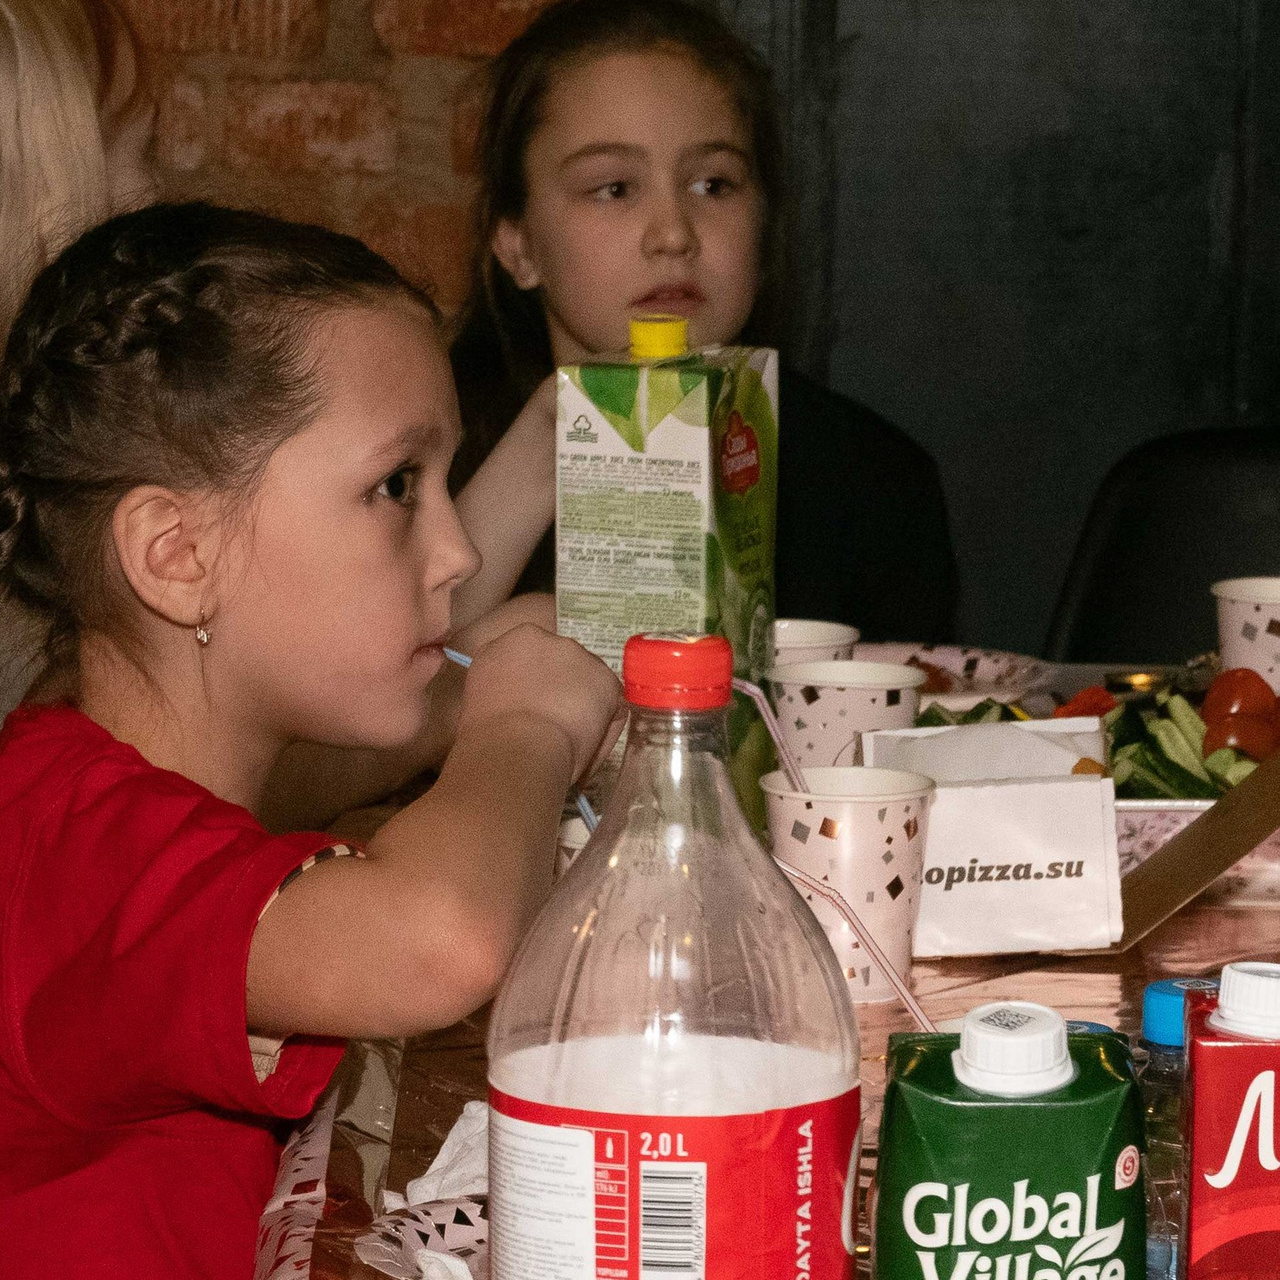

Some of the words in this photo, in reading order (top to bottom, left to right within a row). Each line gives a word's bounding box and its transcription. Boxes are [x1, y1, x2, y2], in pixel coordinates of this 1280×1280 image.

[920, 858, 1085, 891] opizza.su
[640, 1132, 672, 1159] 2,0
[676, 1133, 689, 1157] L
[797, 1119, 814, 1195] ISHLA
[902, 1173, 1101, 1248] Global
